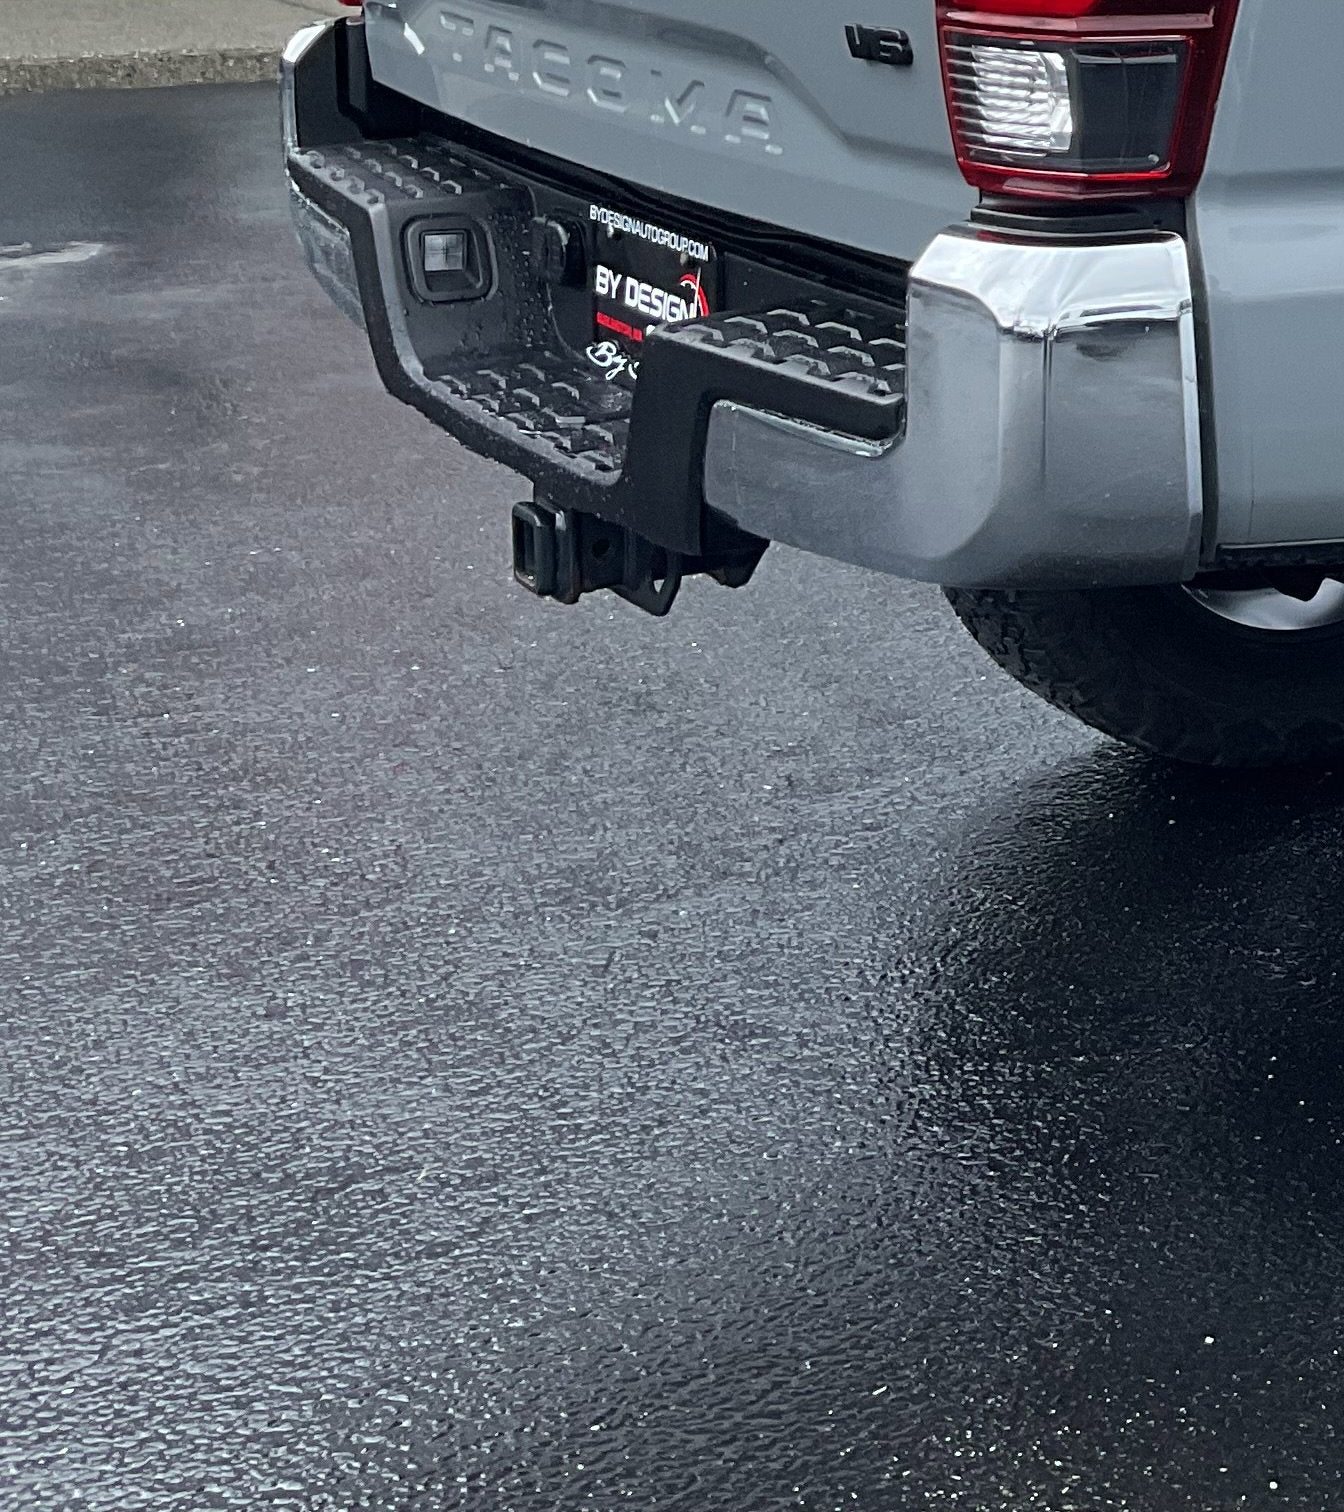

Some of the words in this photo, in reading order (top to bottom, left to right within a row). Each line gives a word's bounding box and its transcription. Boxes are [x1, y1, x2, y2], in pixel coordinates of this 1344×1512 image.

[844, 23, 915, 66] V6
[437, 9, 785, 156] TACOMA
[589, 204, 710, 262] BYDESIGNAUTOGROUP.COM
[595, 264, 622, 299] BY
[624, 276, 698, 323] DESIGN
